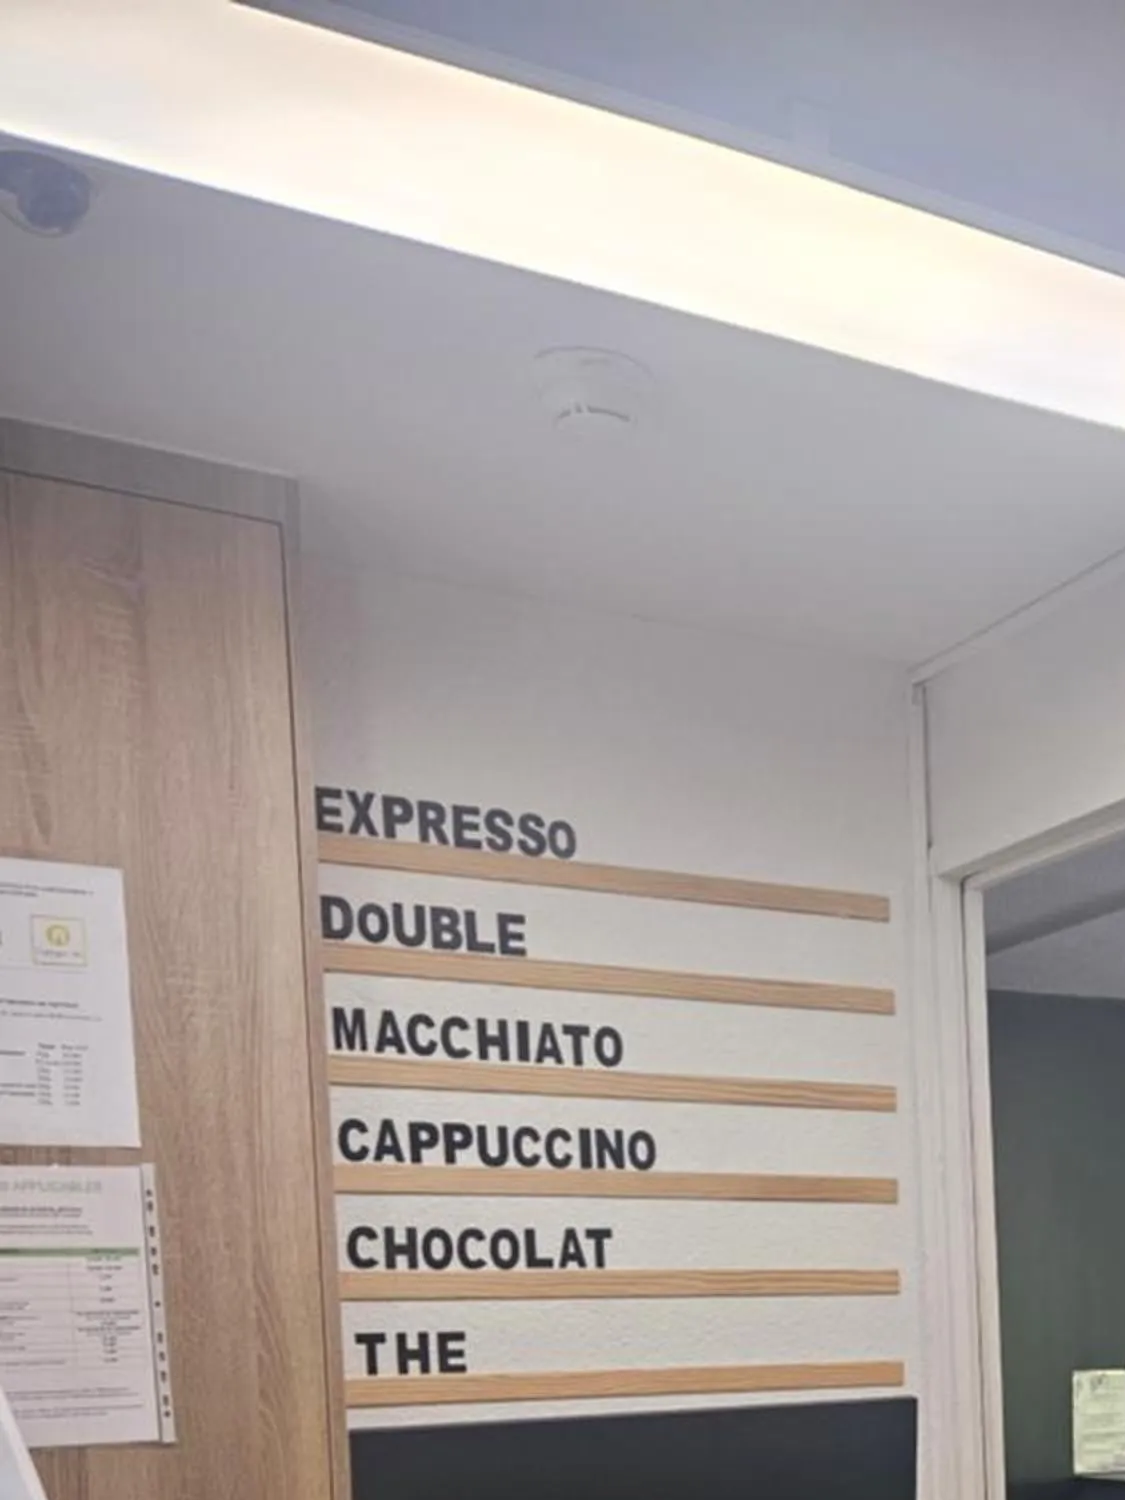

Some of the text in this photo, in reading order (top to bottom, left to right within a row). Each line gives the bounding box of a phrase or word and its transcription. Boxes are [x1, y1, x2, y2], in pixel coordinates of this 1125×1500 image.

[315, 786, 577, 859] EXPRESSO
[320, 895, 527, 957] DOUBLE
[332, 1007, 624, 1067] MACCHIATO
[338, 1118, 656, 1171] CAPPUCCINO
[346, 1225, 613, 1270] CHOCOLAT
[355, 1331, 467, 1375] THE
